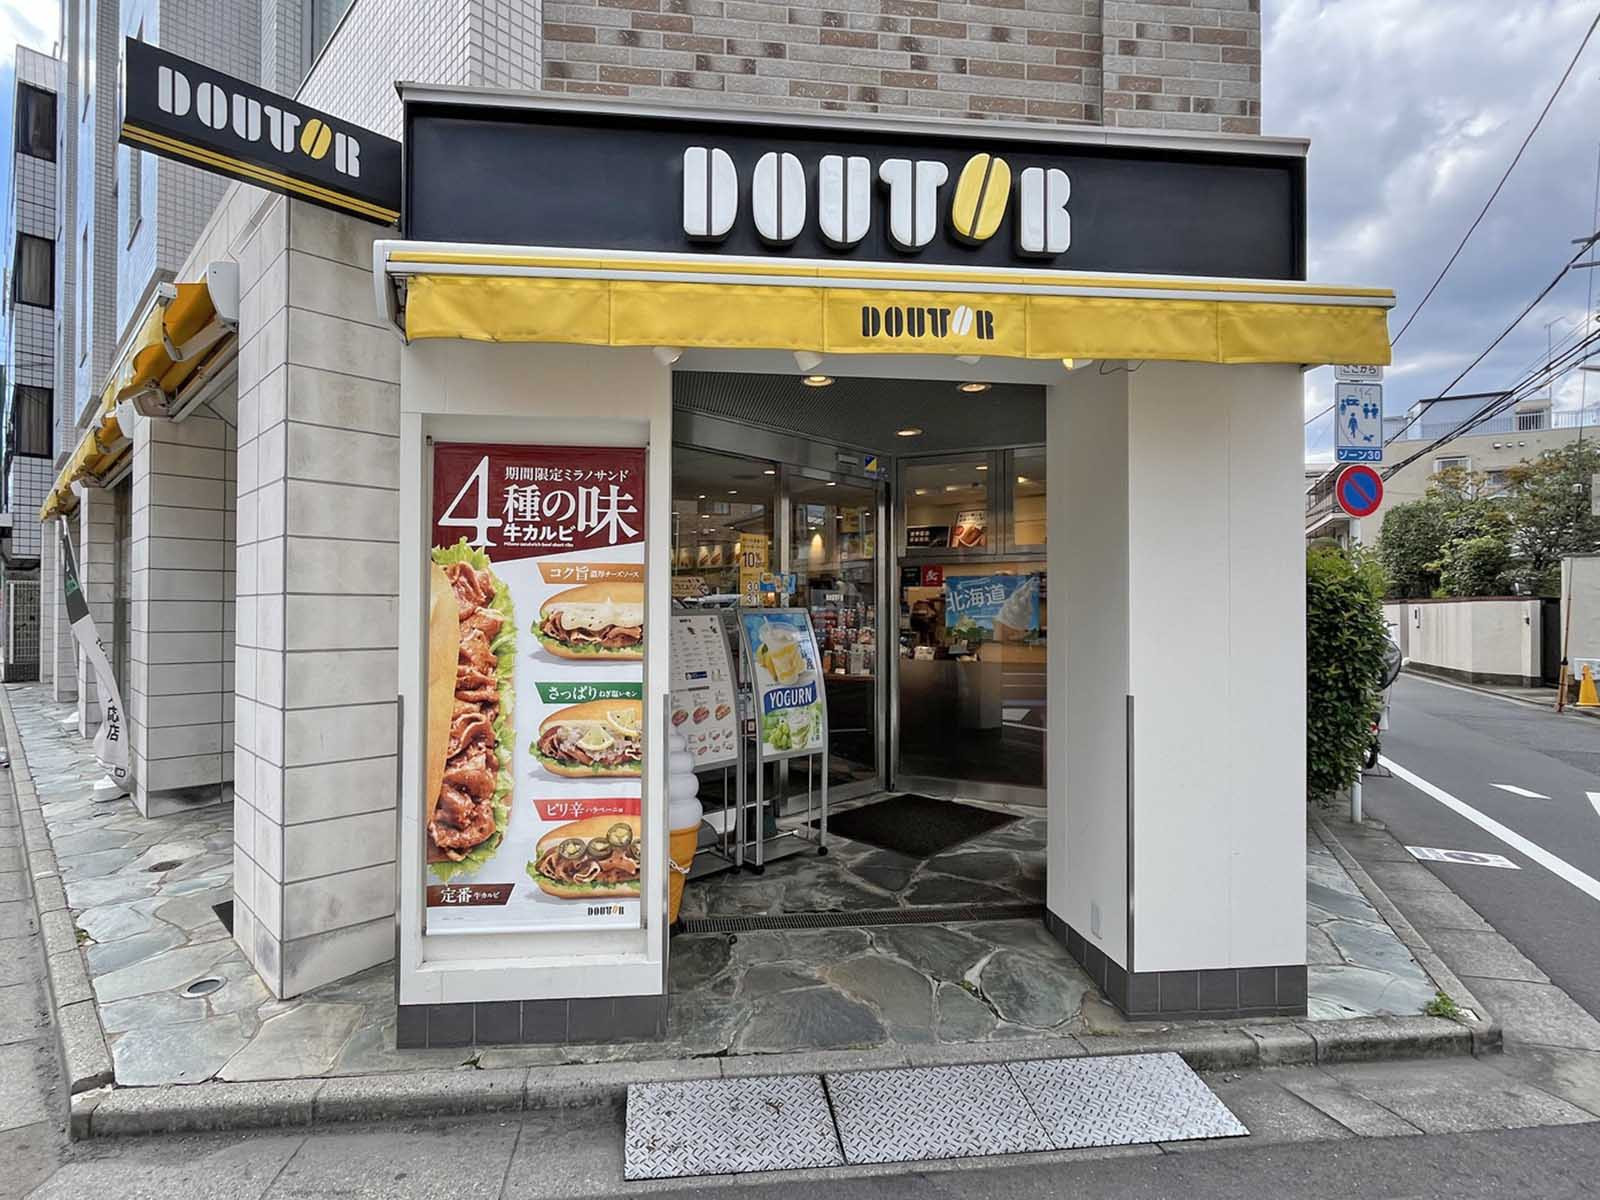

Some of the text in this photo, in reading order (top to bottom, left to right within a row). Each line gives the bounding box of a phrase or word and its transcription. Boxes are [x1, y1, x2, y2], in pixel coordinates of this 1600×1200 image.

[157, 64, 361, 179] DOUTOR
[682, 146, 1072, 256] DOUTOR
[861, 304, 995, 341] DOUTOR
[1338, 450, 1381, 460] ゾーン30
[504, 466, 630, 483] 期間限定ミラノサンド
[503, 523, 577, 542] 牛カルビ
[550, 565, 589, 581] コク旨
[946, 584, 1006, 612] 北海道
[548, 686, 597, 701] さっぱり
[769, 687, 812, 709] YOGURN
[547, 801, 585, 818] ピリ辛
[440, 887, 472, 904] 定番
[587, 904, 625, 916] DOUTOR
